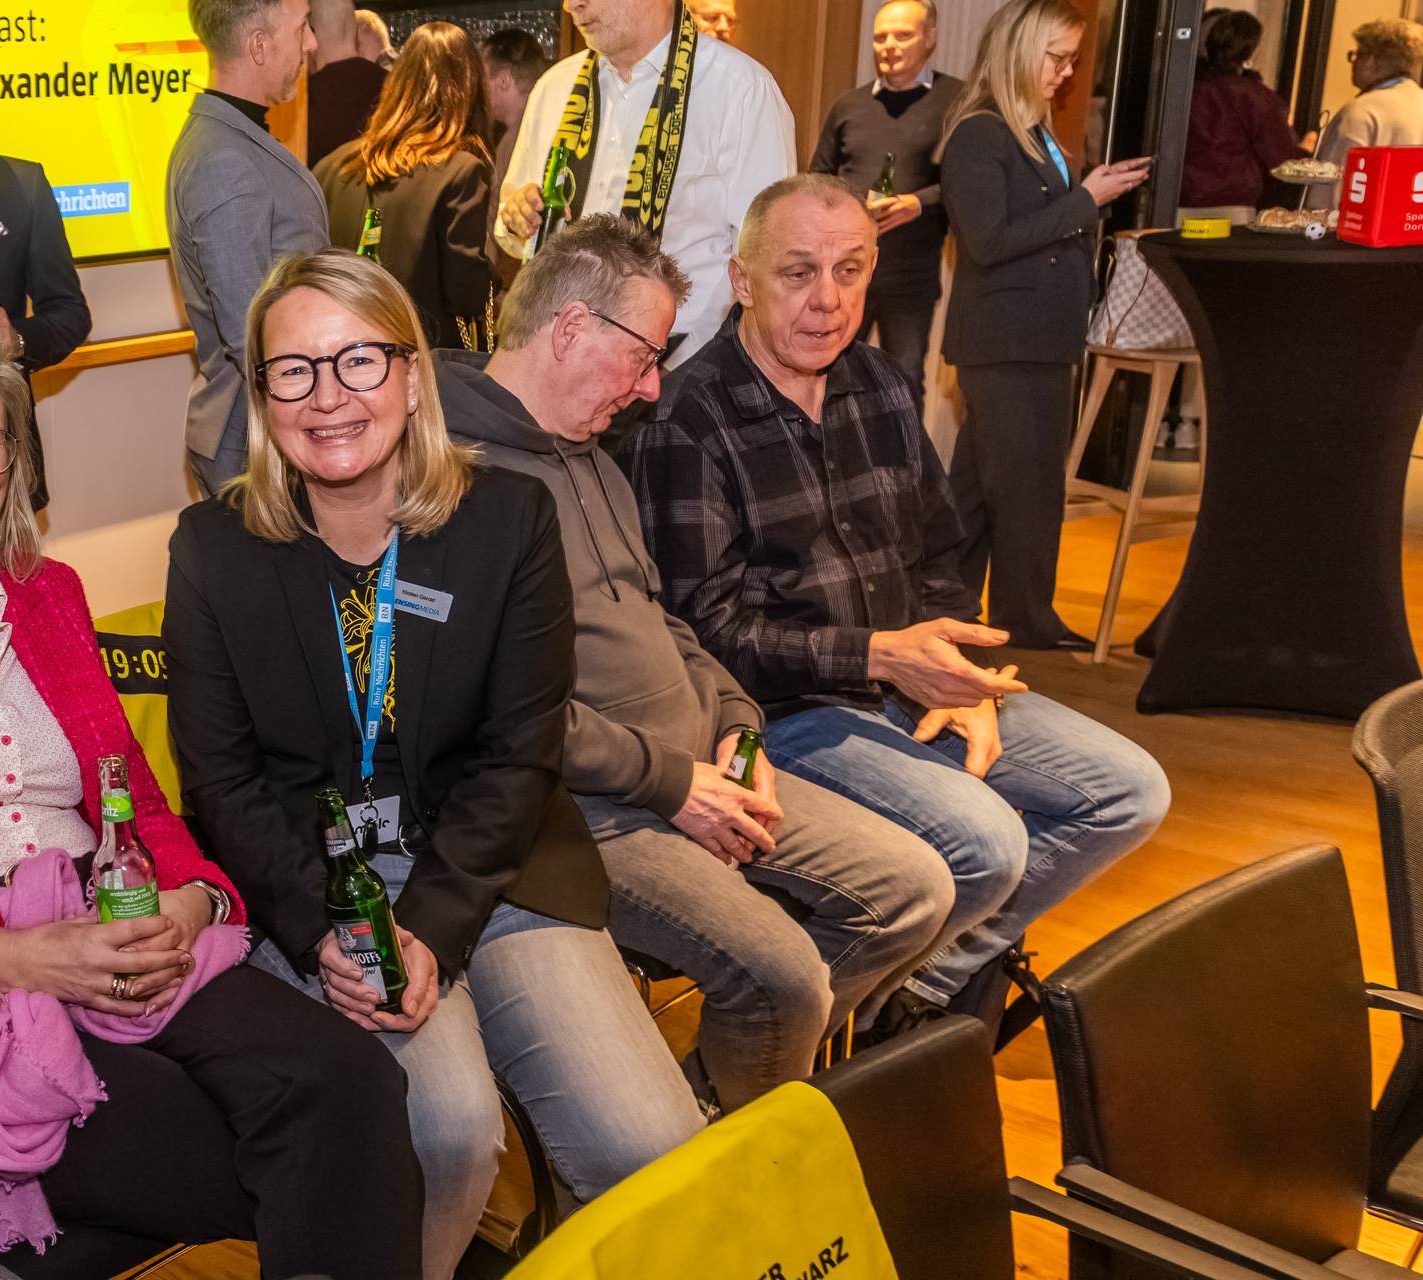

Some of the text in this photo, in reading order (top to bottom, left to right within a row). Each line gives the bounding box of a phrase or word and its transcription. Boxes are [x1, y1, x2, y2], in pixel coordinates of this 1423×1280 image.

[109, 62, 191, 103] Meyer
[657, 143, 678, 199] BORUSSIA
[56, 188, 127, 211] hrichten
[381, 606, 389, 619] RN
[395, 598, 440, 616] ENSINGMEDIA
[373, 638, 386, 705] Ruhr Nachrichten
